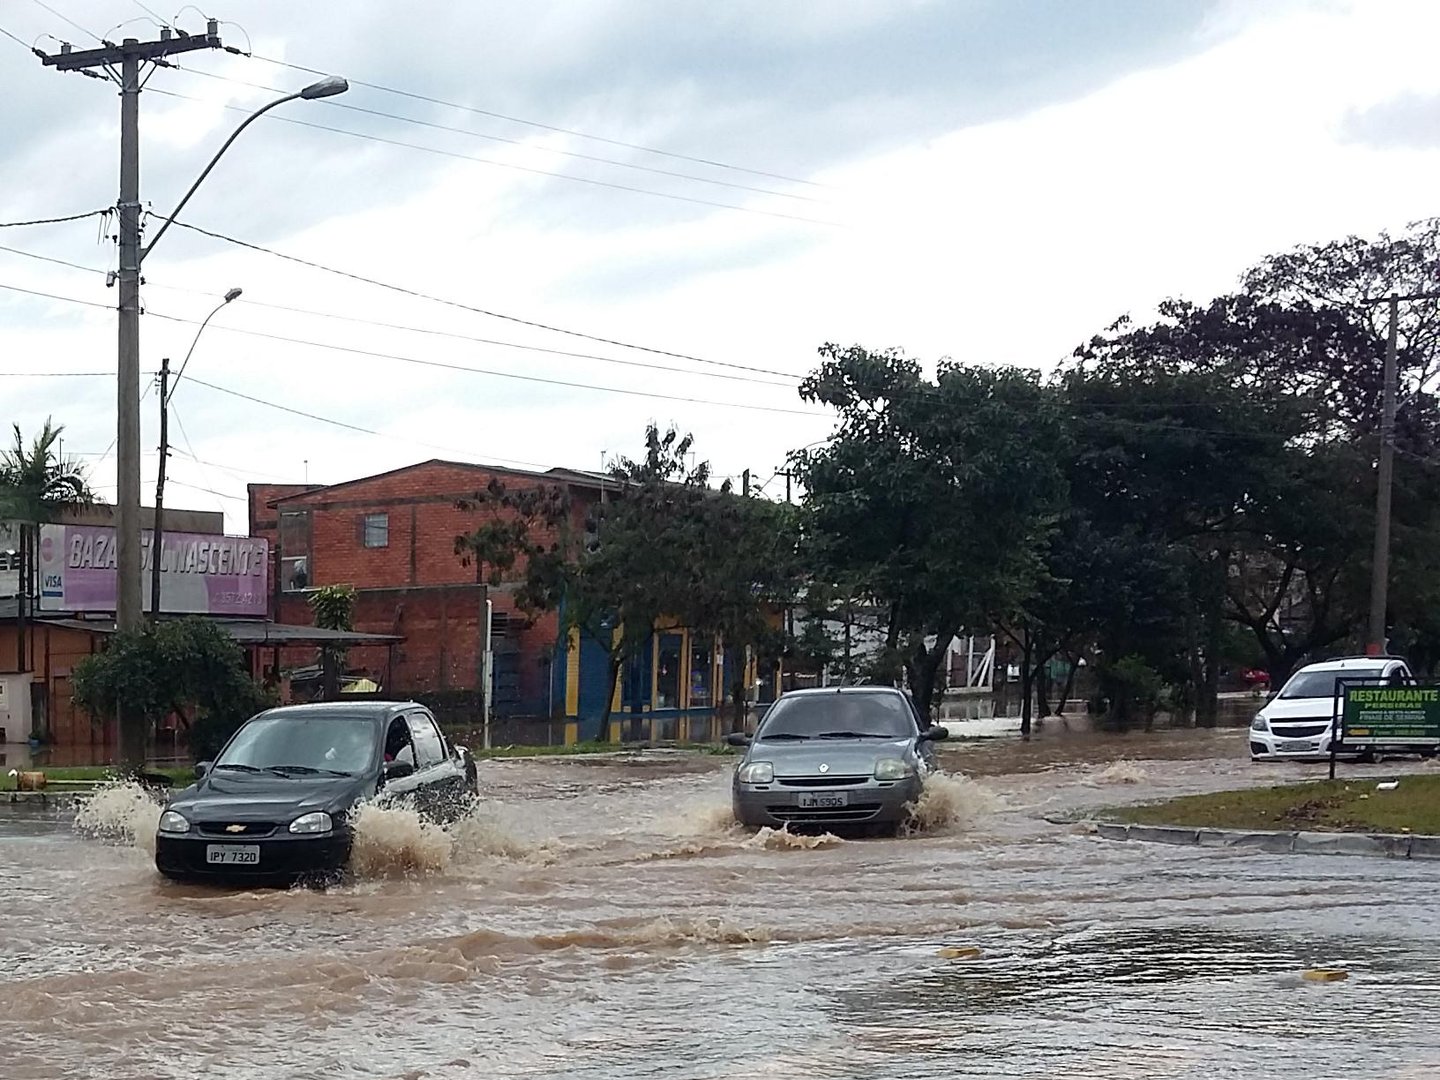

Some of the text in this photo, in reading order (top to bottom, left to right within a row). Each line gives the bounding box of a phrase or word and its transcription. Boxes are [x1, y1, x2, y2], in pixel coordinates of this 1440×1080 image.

[68, 533, 118, 570] BAZA
[172, 538, 267, 577] NASCENTE
[44, 575, 63, 588] VISA
[1350, 690, 1438, 701] RESTAURANTE
[232, 852, 256, 862] 7320
